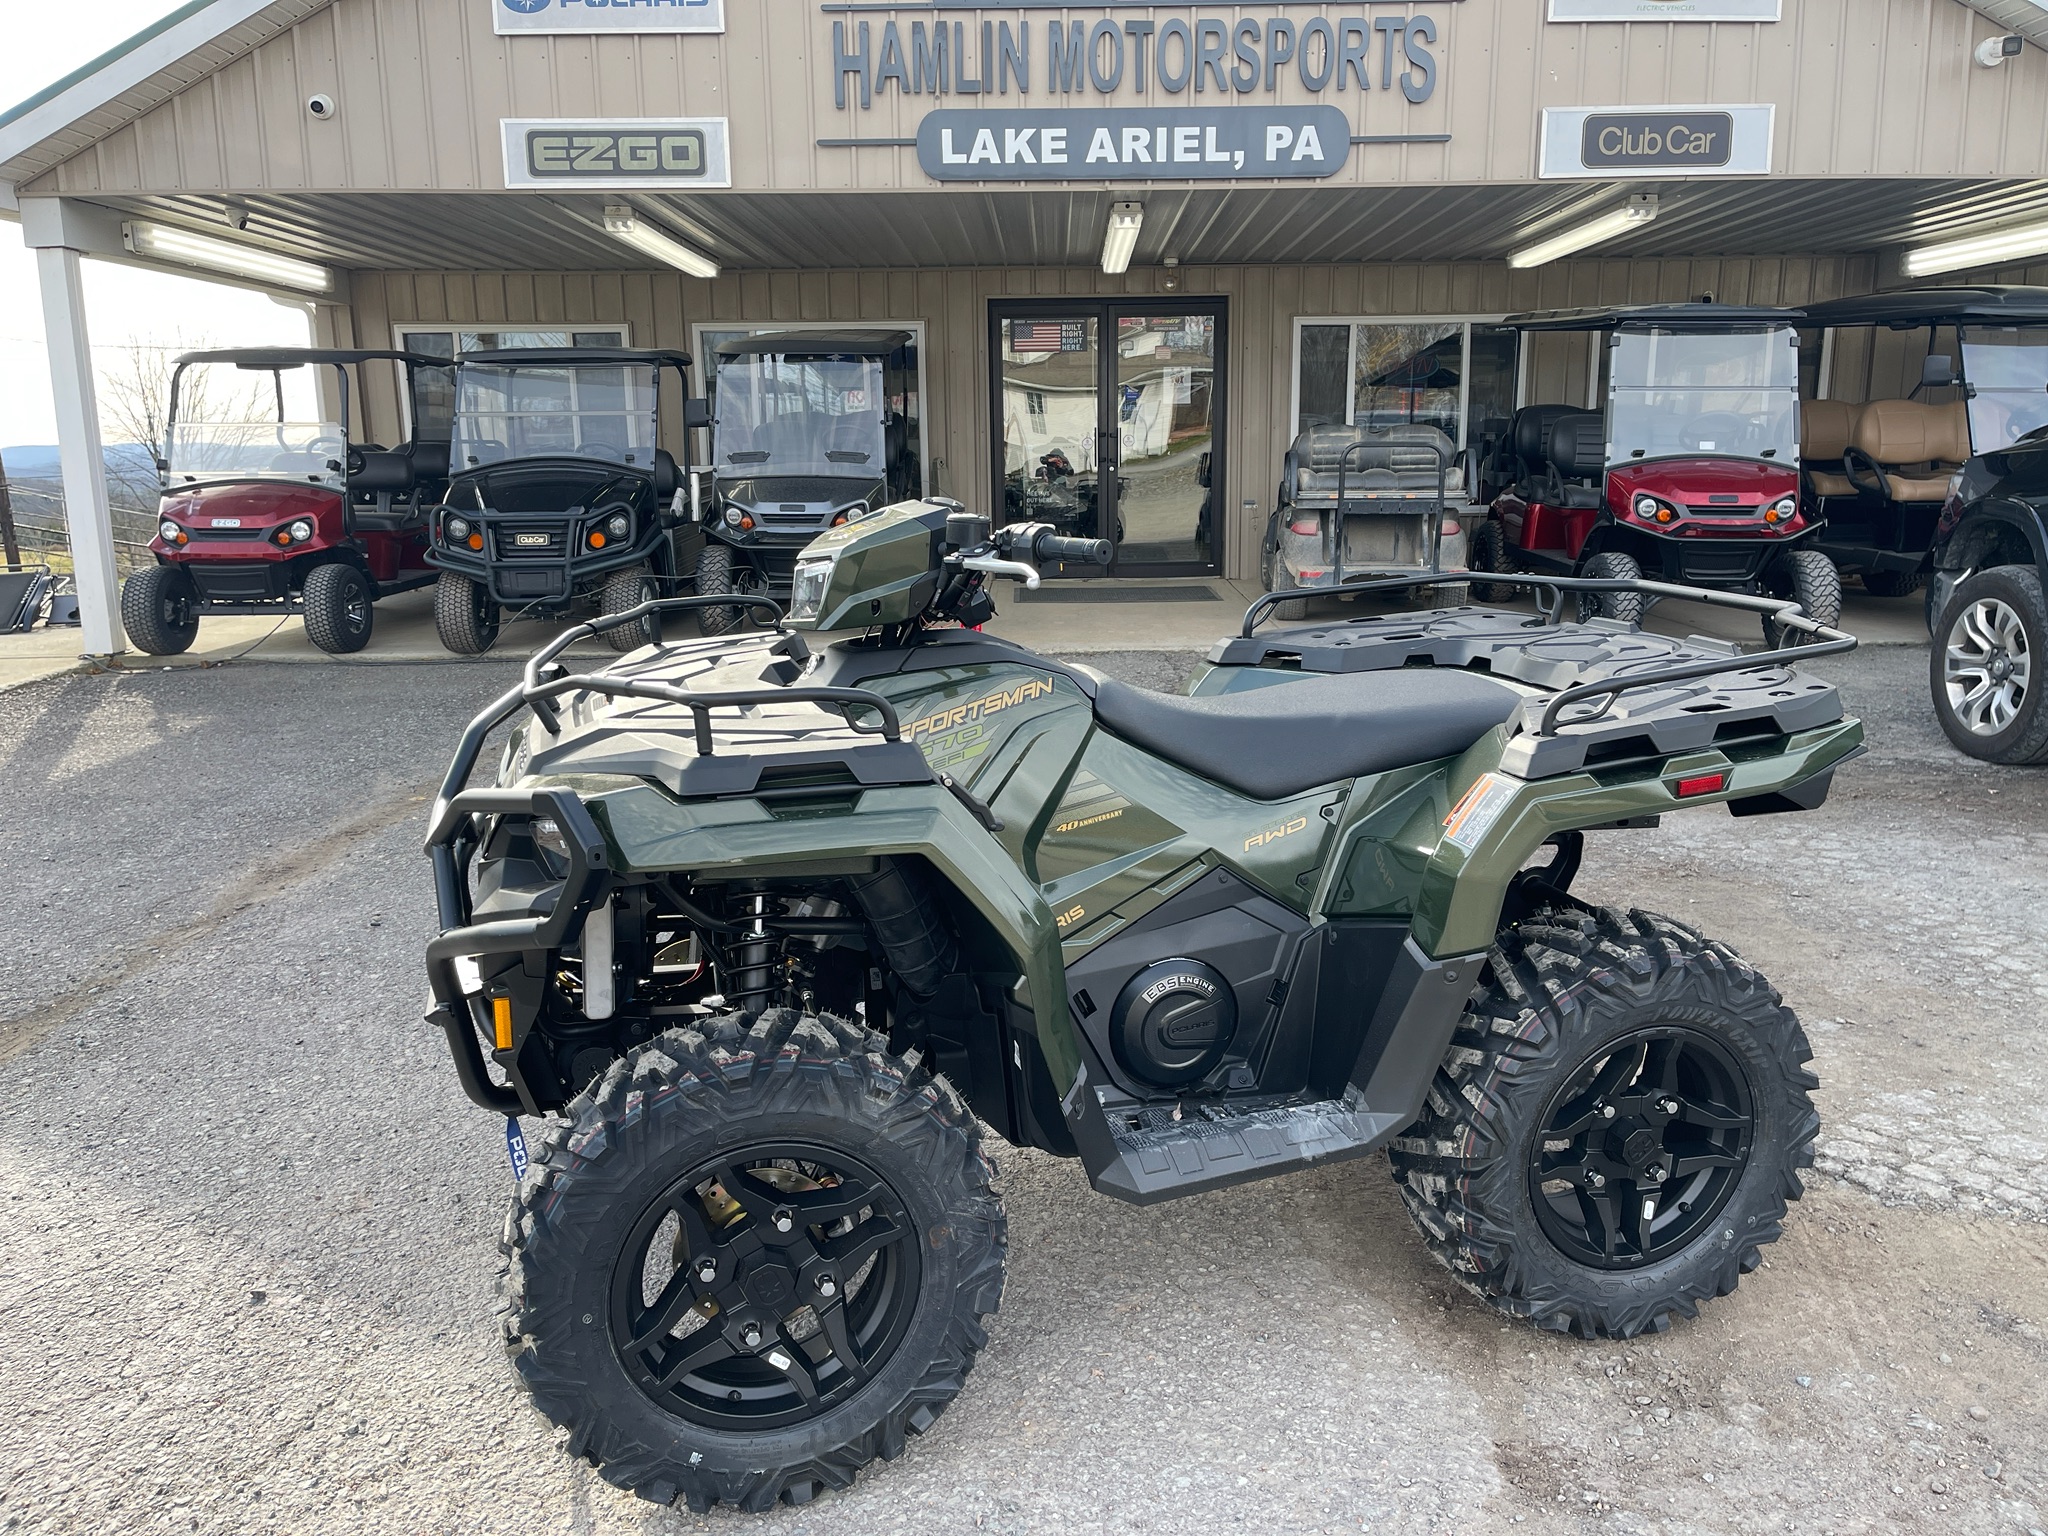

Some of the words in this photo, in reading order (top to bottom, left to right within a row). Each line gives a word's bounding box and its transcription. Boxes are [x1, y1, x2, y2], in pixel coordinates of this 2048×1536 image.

[833, 20, 1029, 109] HAMLIN
[1049, 15, 1437, 103] MOTORSPORTS
[532, 137, 700, 171] EZGO
[941, 128, 1068, 164] LAKE
[1085, 127, 1245, 171] ARIEL,
[1265, 125, 1325, 161] PA
[1598, 126, 1662, 156] Club
[1666, 125, 1716, 155] Car
[932, 751, 965, 770] EFI
[1056, 820, 1080, 832] 40
[1079, 809, 1123, 827] ANNIVERSARY
[1244, 815, 1308, 853] AWD
[1146, 977, 1177, 1000] EBS
[1180, 976, 1215, 992] ENGINE
[1171, 1020, 1215, 1035] POLARIS
